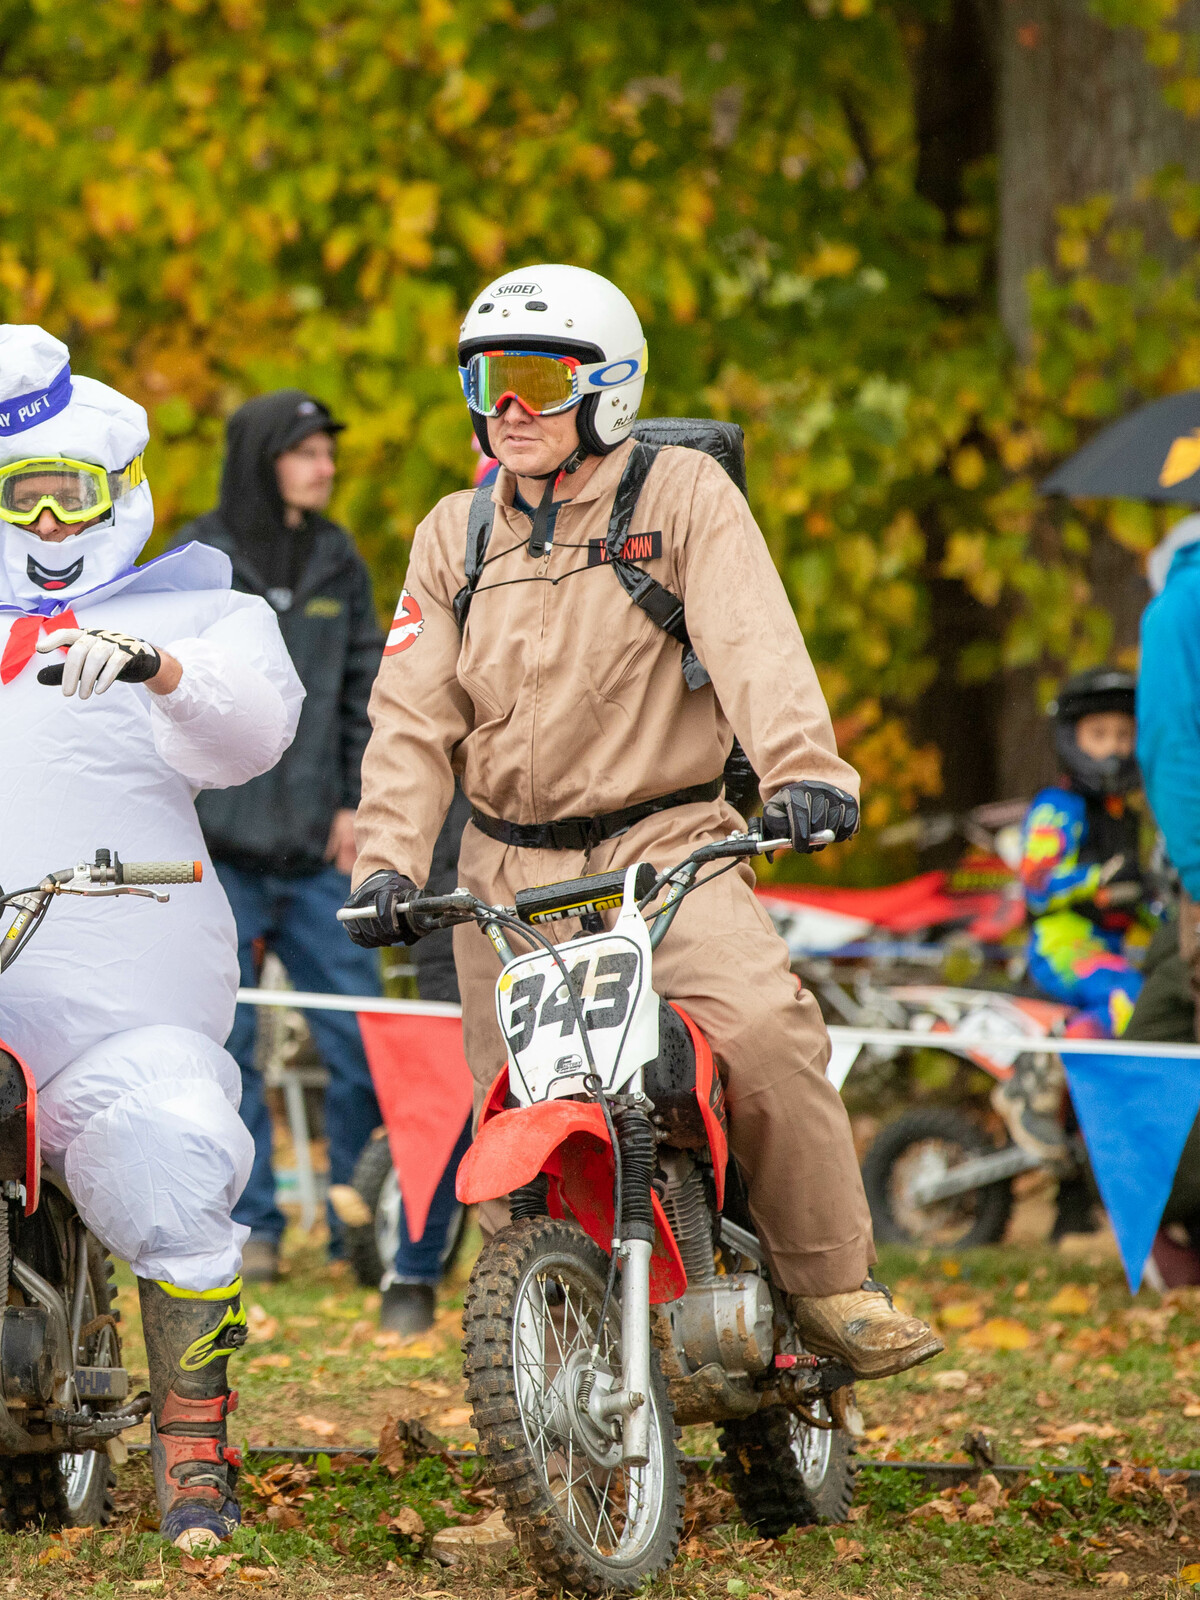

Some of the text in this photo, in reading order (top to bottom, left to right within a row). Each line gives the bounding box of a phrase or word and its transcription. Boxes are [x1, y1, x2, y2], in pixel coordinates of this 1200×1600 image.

[496, 284, 536, 295] SHOEI
[17, 393, 51, 423] PUFT
[600, 534, 653, 562] VKMAN
[508, 952, 638, 1055] 343
